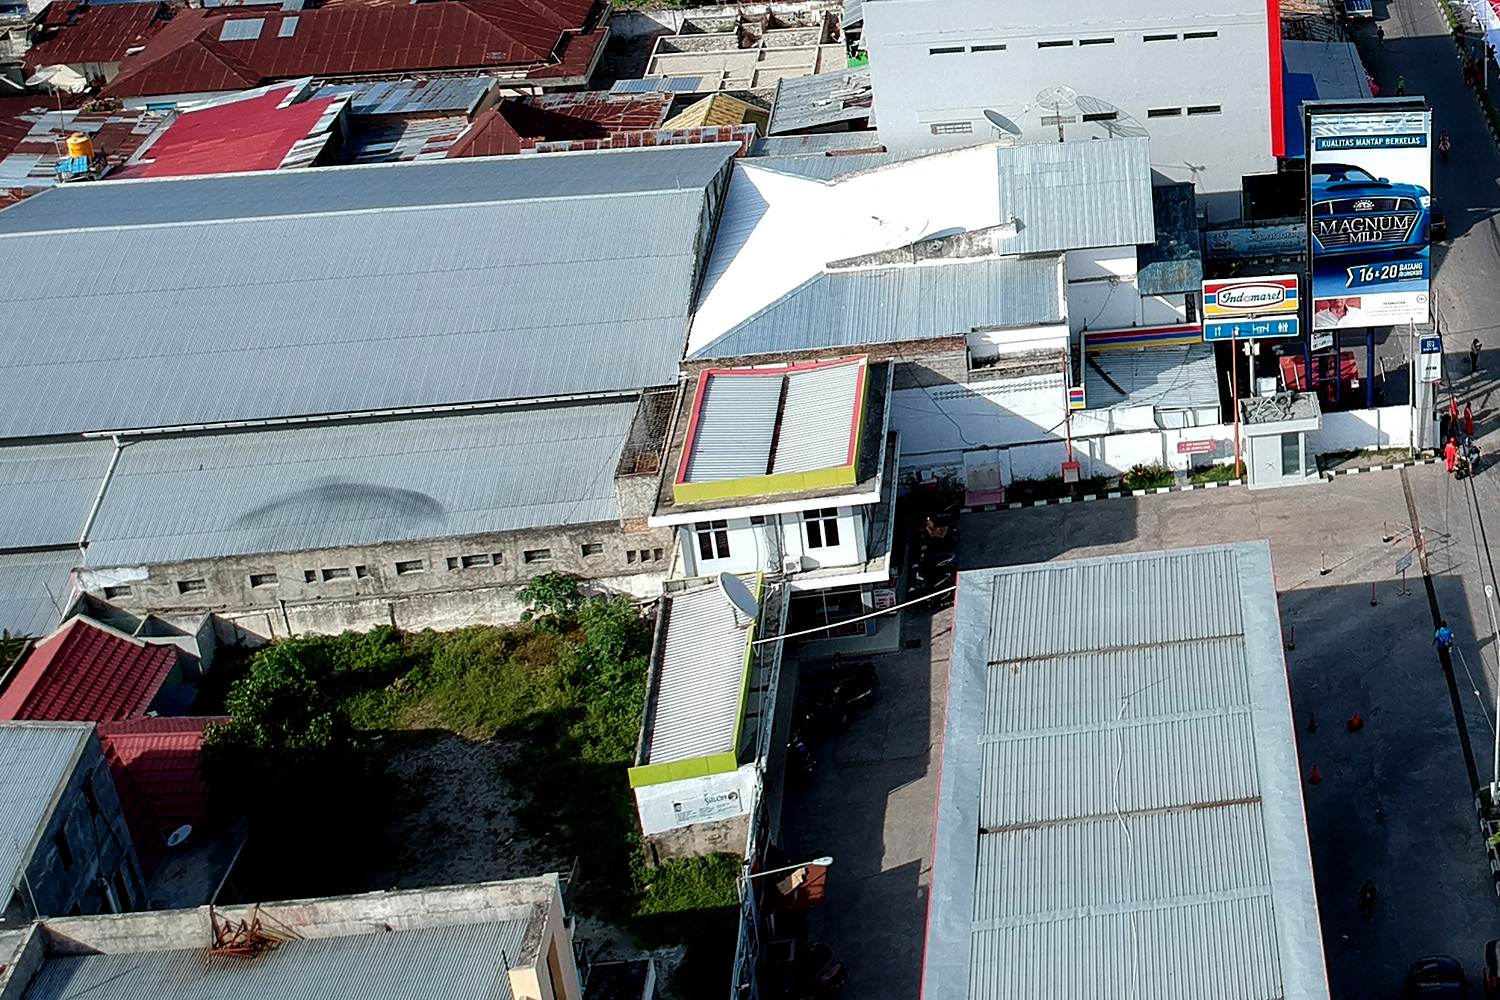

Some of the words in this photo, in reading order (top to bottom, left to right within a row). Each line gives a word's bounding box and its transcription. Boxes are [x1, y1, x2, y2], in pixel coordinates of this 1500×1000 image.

[1321, 138, 1354, 148] KUALITAS
[1356, 137, 1383, 147] MANTAP
[1385, 136, 1421, 146] BERKELAS
[1319, 216, 1410, 236] MAGNUM
[1349, 231, 1383, 243] MILD
[1399, 262, 1423, 271] BATANG
[1360, 267, 1373, 282] 16
[1381, 265, 1398, 280] 20
[1221, 289, 1282, 304] Indomaret
